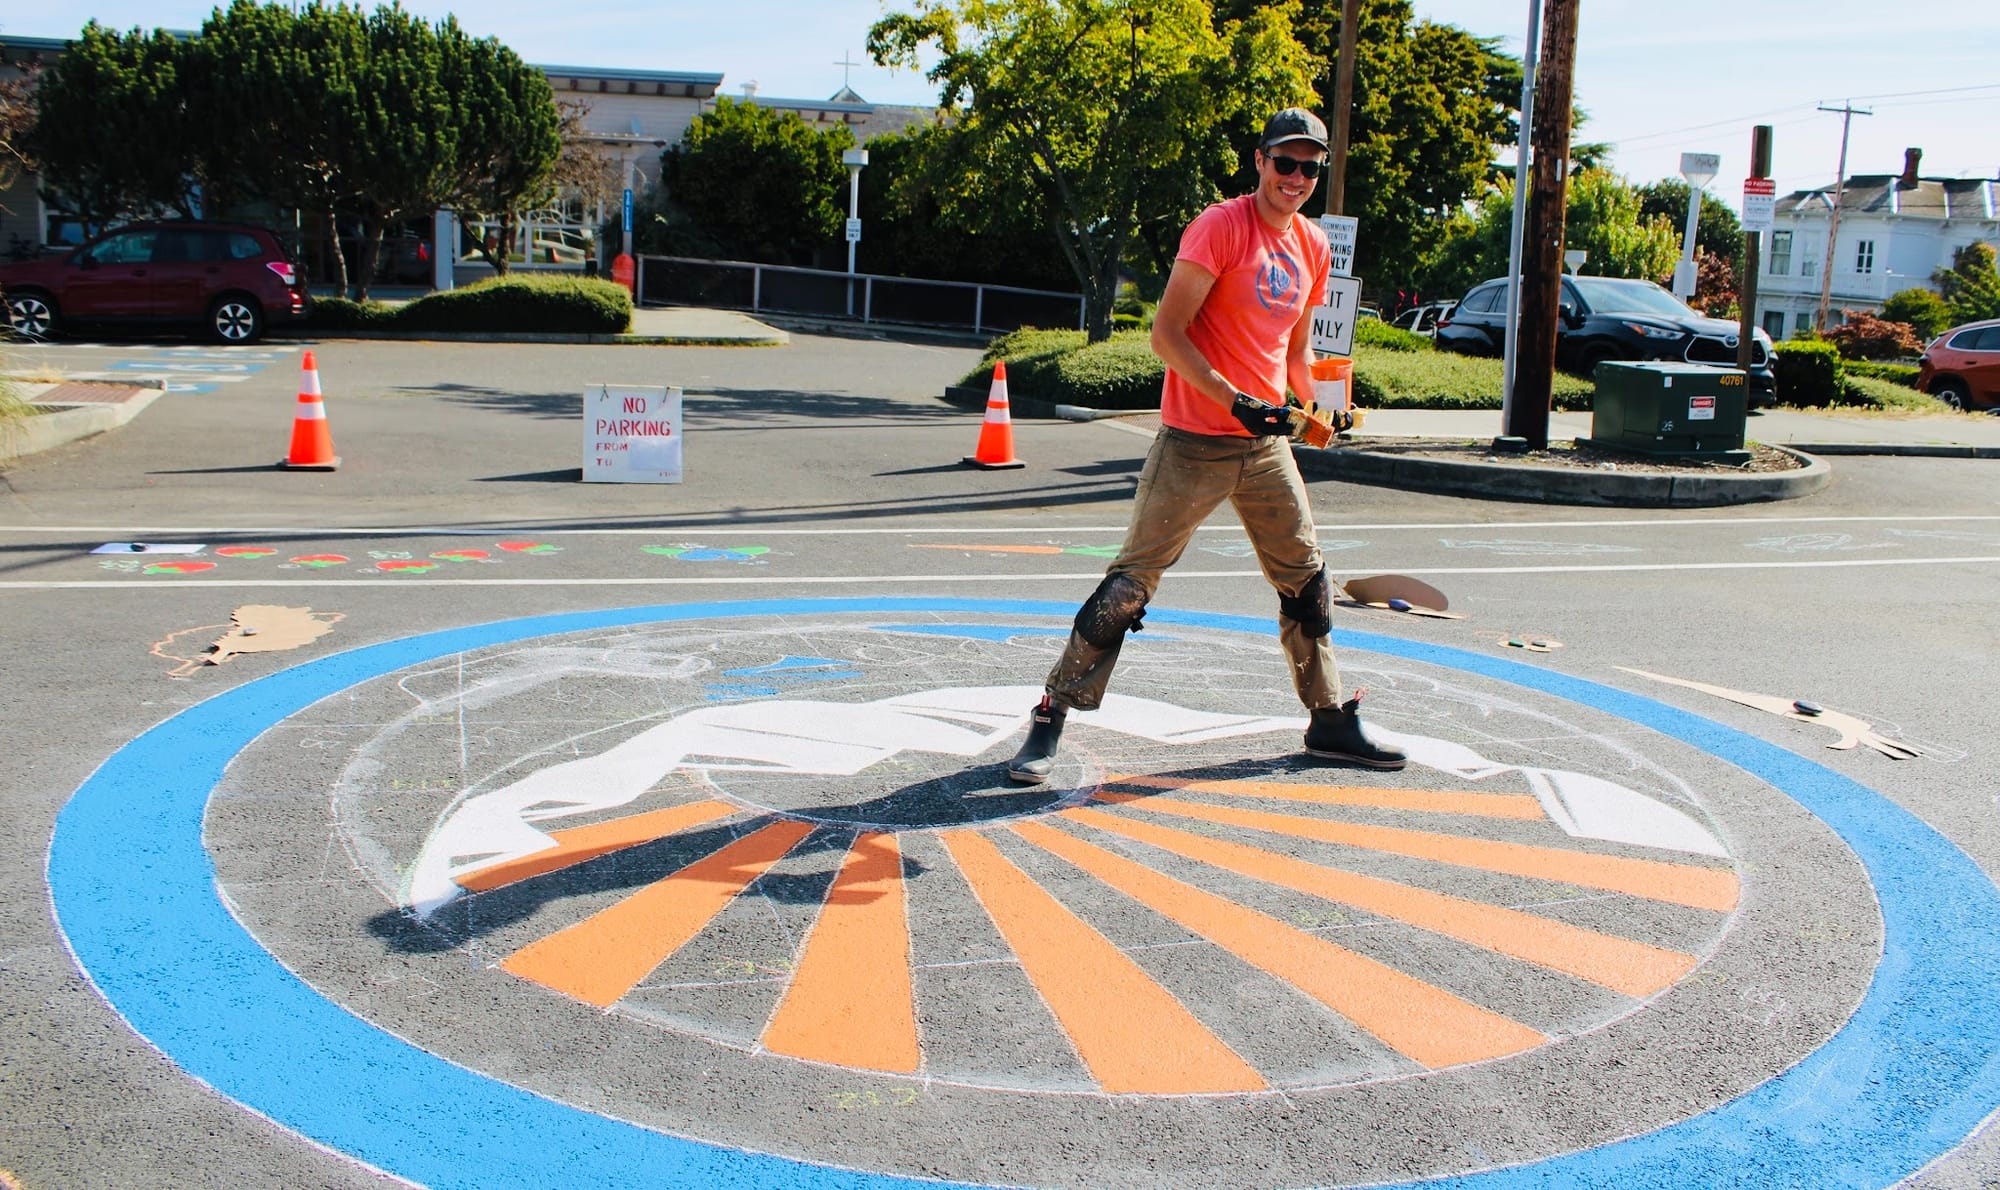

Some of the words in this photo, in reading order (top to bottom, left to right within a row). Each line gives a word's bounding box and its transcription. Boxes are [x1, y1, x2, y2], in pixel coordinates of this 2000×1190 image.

[1324, 222, 1354, 233] COMMUNITY
[1330, 242, 1352, 256] RKING
[1330, 256, 1348, 270] NLY
[1329, 289, 1344, 309] IT
[1313, 318, 1343, 339] NLY
[1720, 375, 1744, 386] 40761
[623, 397, 647, 414] NO
[596, 419, 671, 437] PARKING
[596, 442, 628, 452] FROM
